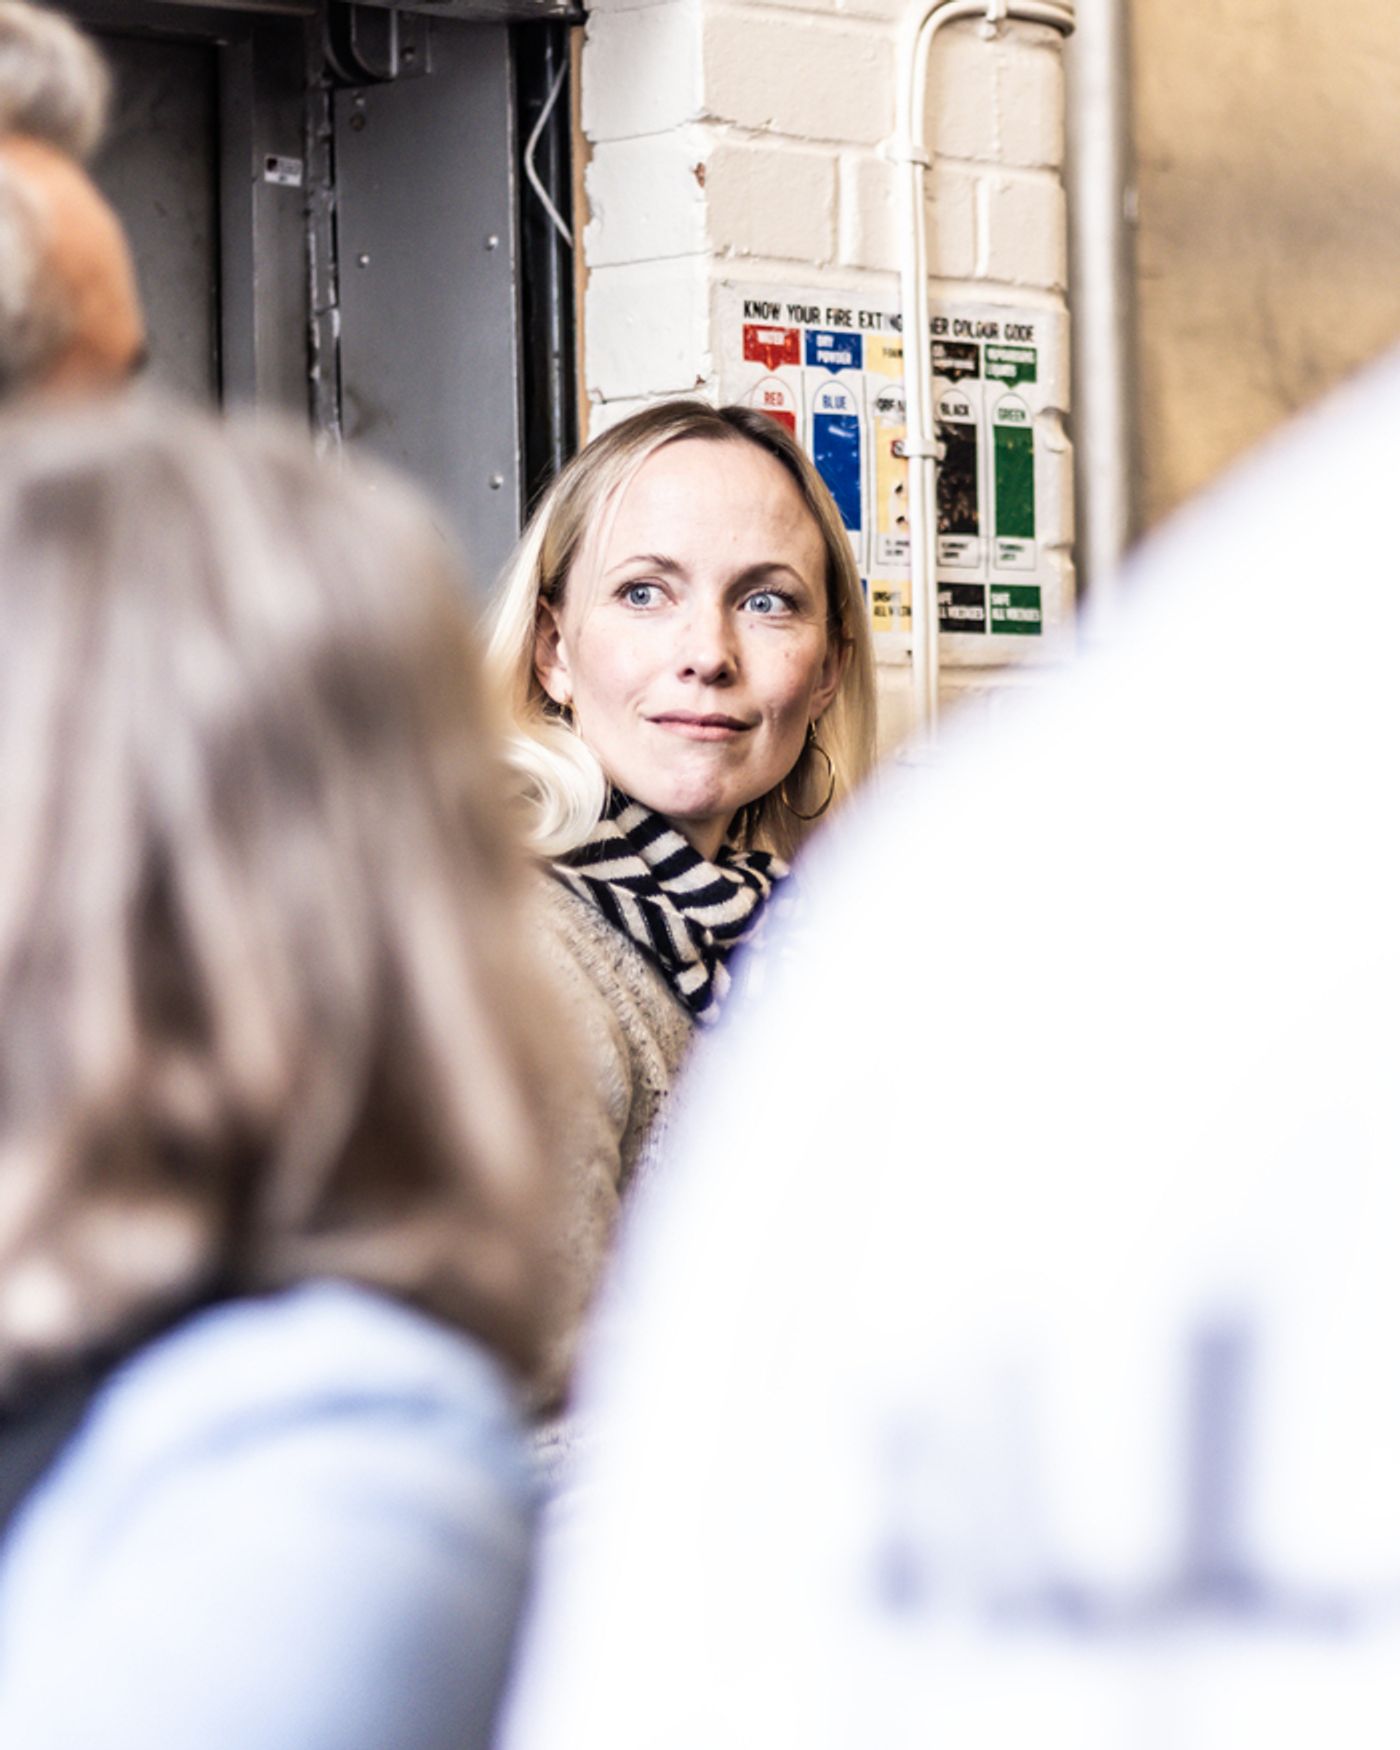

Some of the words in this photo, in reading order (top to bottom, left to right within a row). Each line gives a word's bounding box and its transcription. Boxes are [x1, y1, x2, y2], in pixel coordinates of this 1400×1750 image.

[744, 300, 781, 320] KNOW
[787, 304, 821, 324] YOUR
[826, 308, 853, 327] FIRE
[764, 391, 784, 406] RED
[822, 395, 847, 410] BLUE
[998, 408, 1026, 421] GREEN
